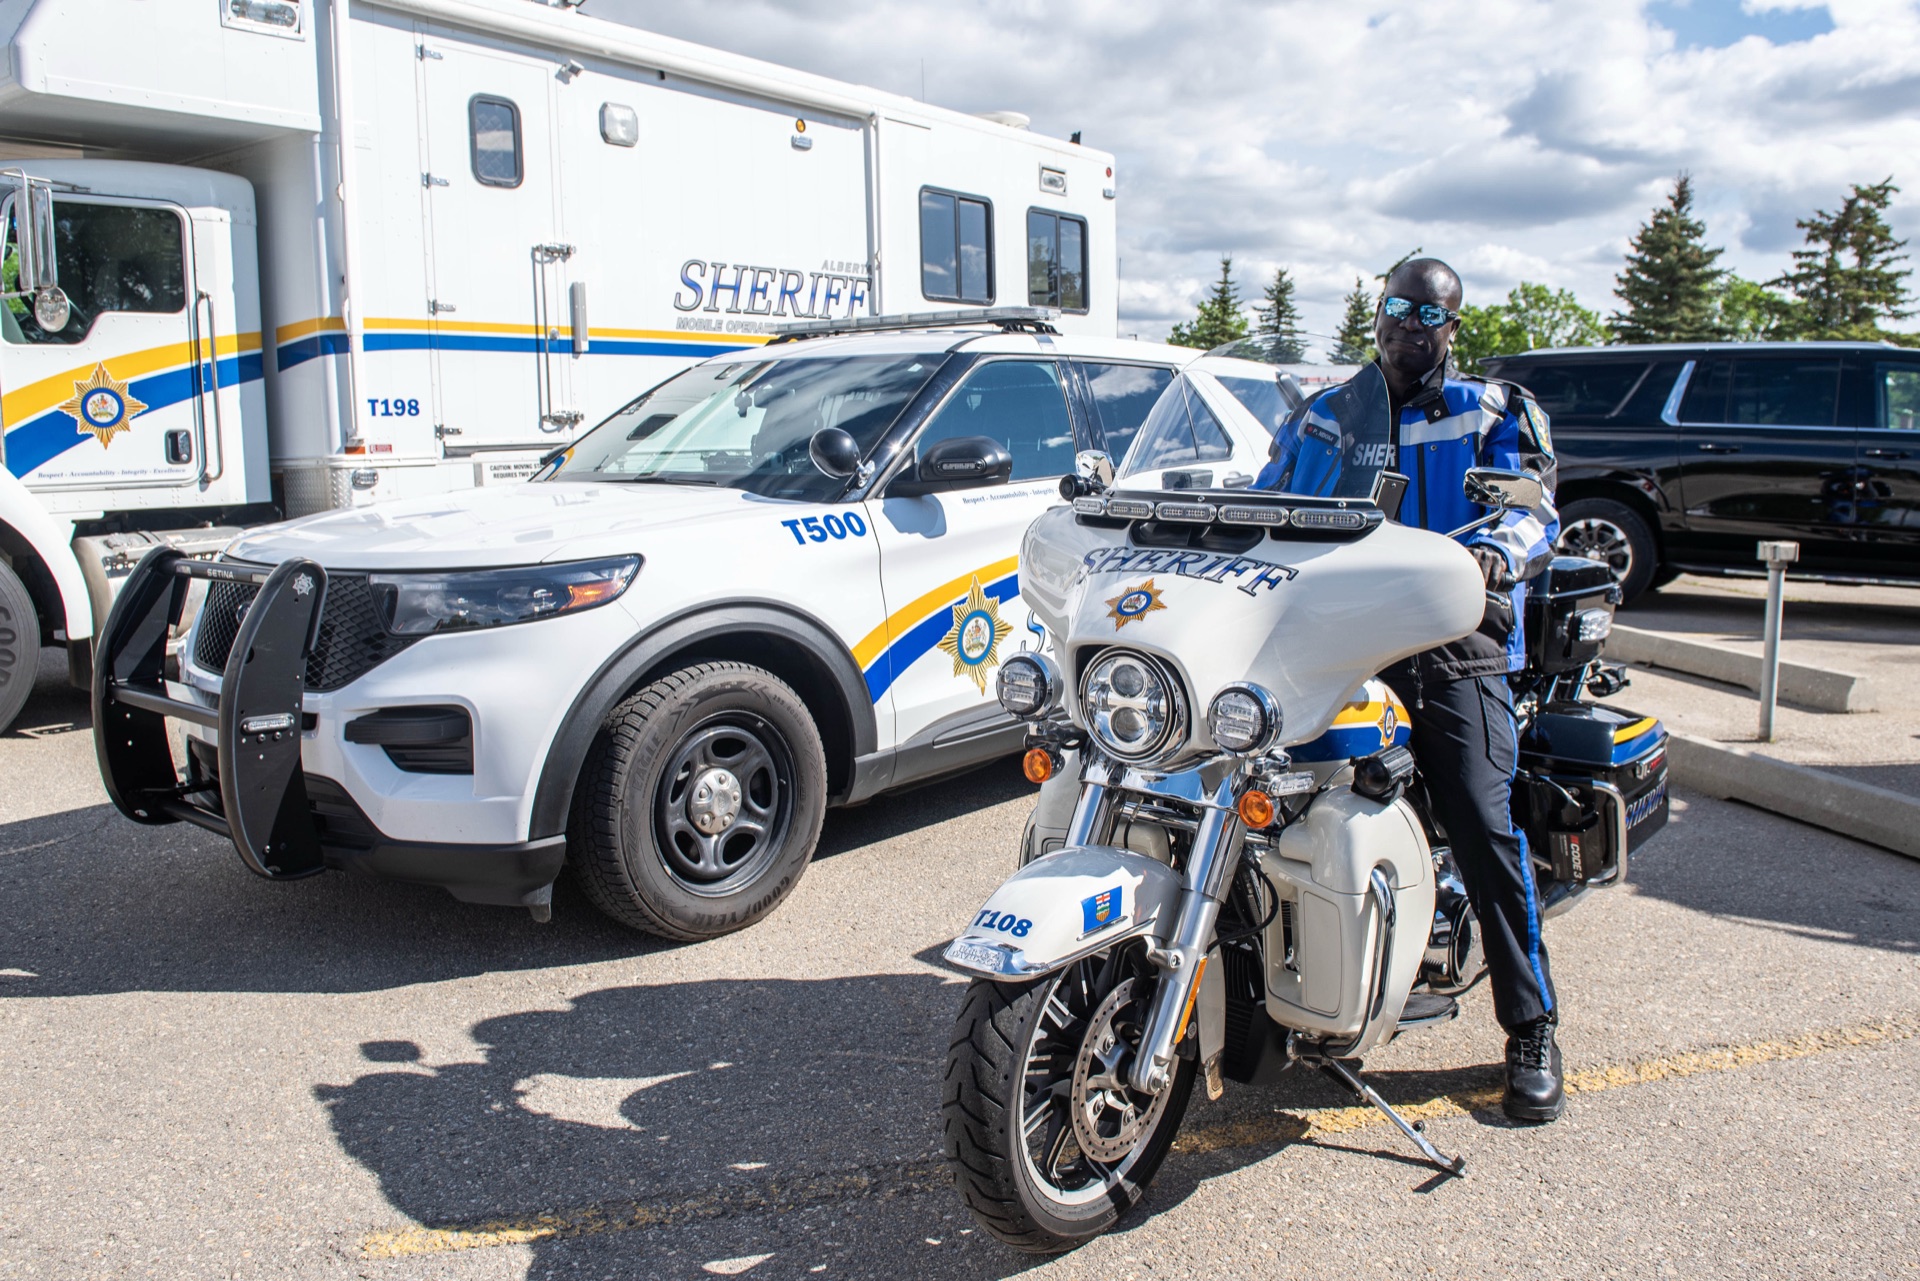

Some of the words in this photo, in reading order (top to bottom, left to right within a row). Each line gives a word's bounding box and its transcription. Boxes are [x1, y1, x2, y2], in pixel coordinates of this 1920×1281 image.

[821, 259, 873, 275] ALBERTA
[674, 259, 873, 319] SHERIFF
[676, 317, 723, 331] MOBILE
[367, 398, 420, 416] T198
[1352, 443, 1397, 467] SHER
[69, 470, 116, 478] Accountability
[121, 468, 148, 476] Integrity
[513, 463, 533, 471] MOVING
[781, 511, 867, 545] T500
[207, 568, 235, 579] SETINA
[1076, 546, 1300, 597] SHERIFF
[631, 732, 663, 792] EAGLE
[1570, 843, 1582, 871] CODE
[1573, 871, 1583, 879] 3
[974, 909, 1033, 938] T108
